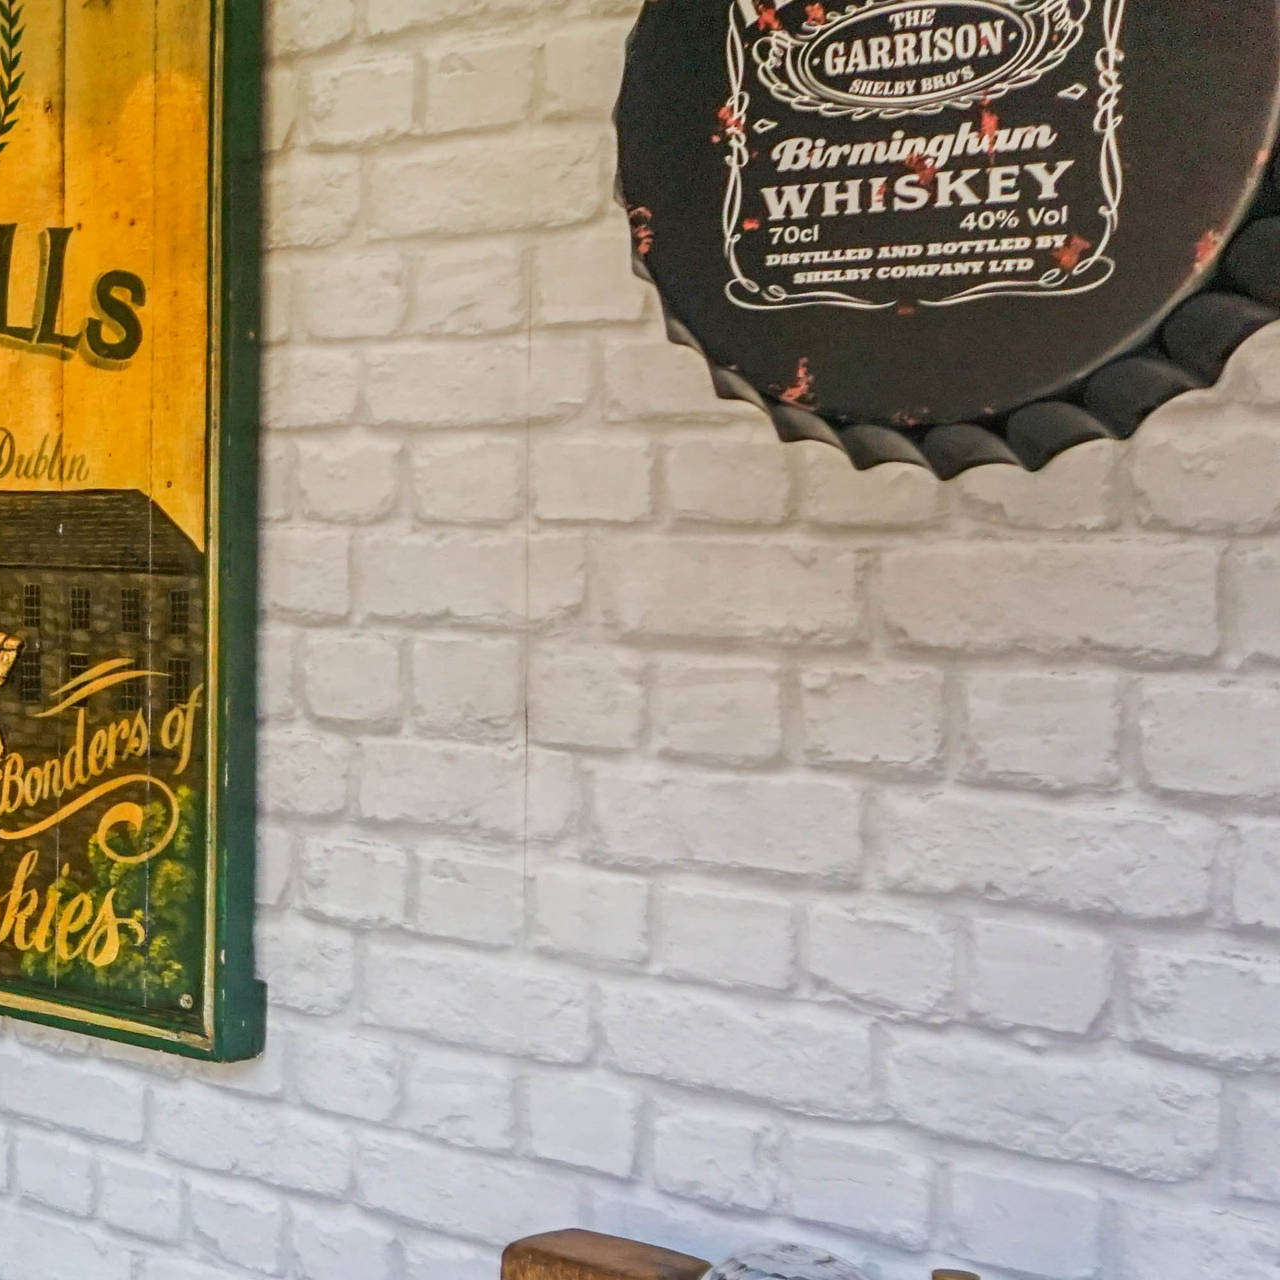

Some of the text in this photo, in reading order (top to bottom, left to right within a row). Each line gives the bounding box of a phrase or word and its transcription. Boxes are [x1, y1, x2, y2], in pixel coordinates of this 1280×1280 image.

[889, 8, 937, 31] THE
[824, 20, 1006, 77] GARRISON
[849, 66, 975, 97] SHELBY BRO'S
[771, 120, 1058, 172] Birmingham
[760, 160, 1075, 221] WHISKEY
[769, 205, 1069, 245] 70cl 40% Vol
[764, 233, 1068, 267] DISTILLED AND BOTTLED BY
[792, 257, 1034, 285] SHELBY COMPANY LTD
[161, 683, 205, 774] of
